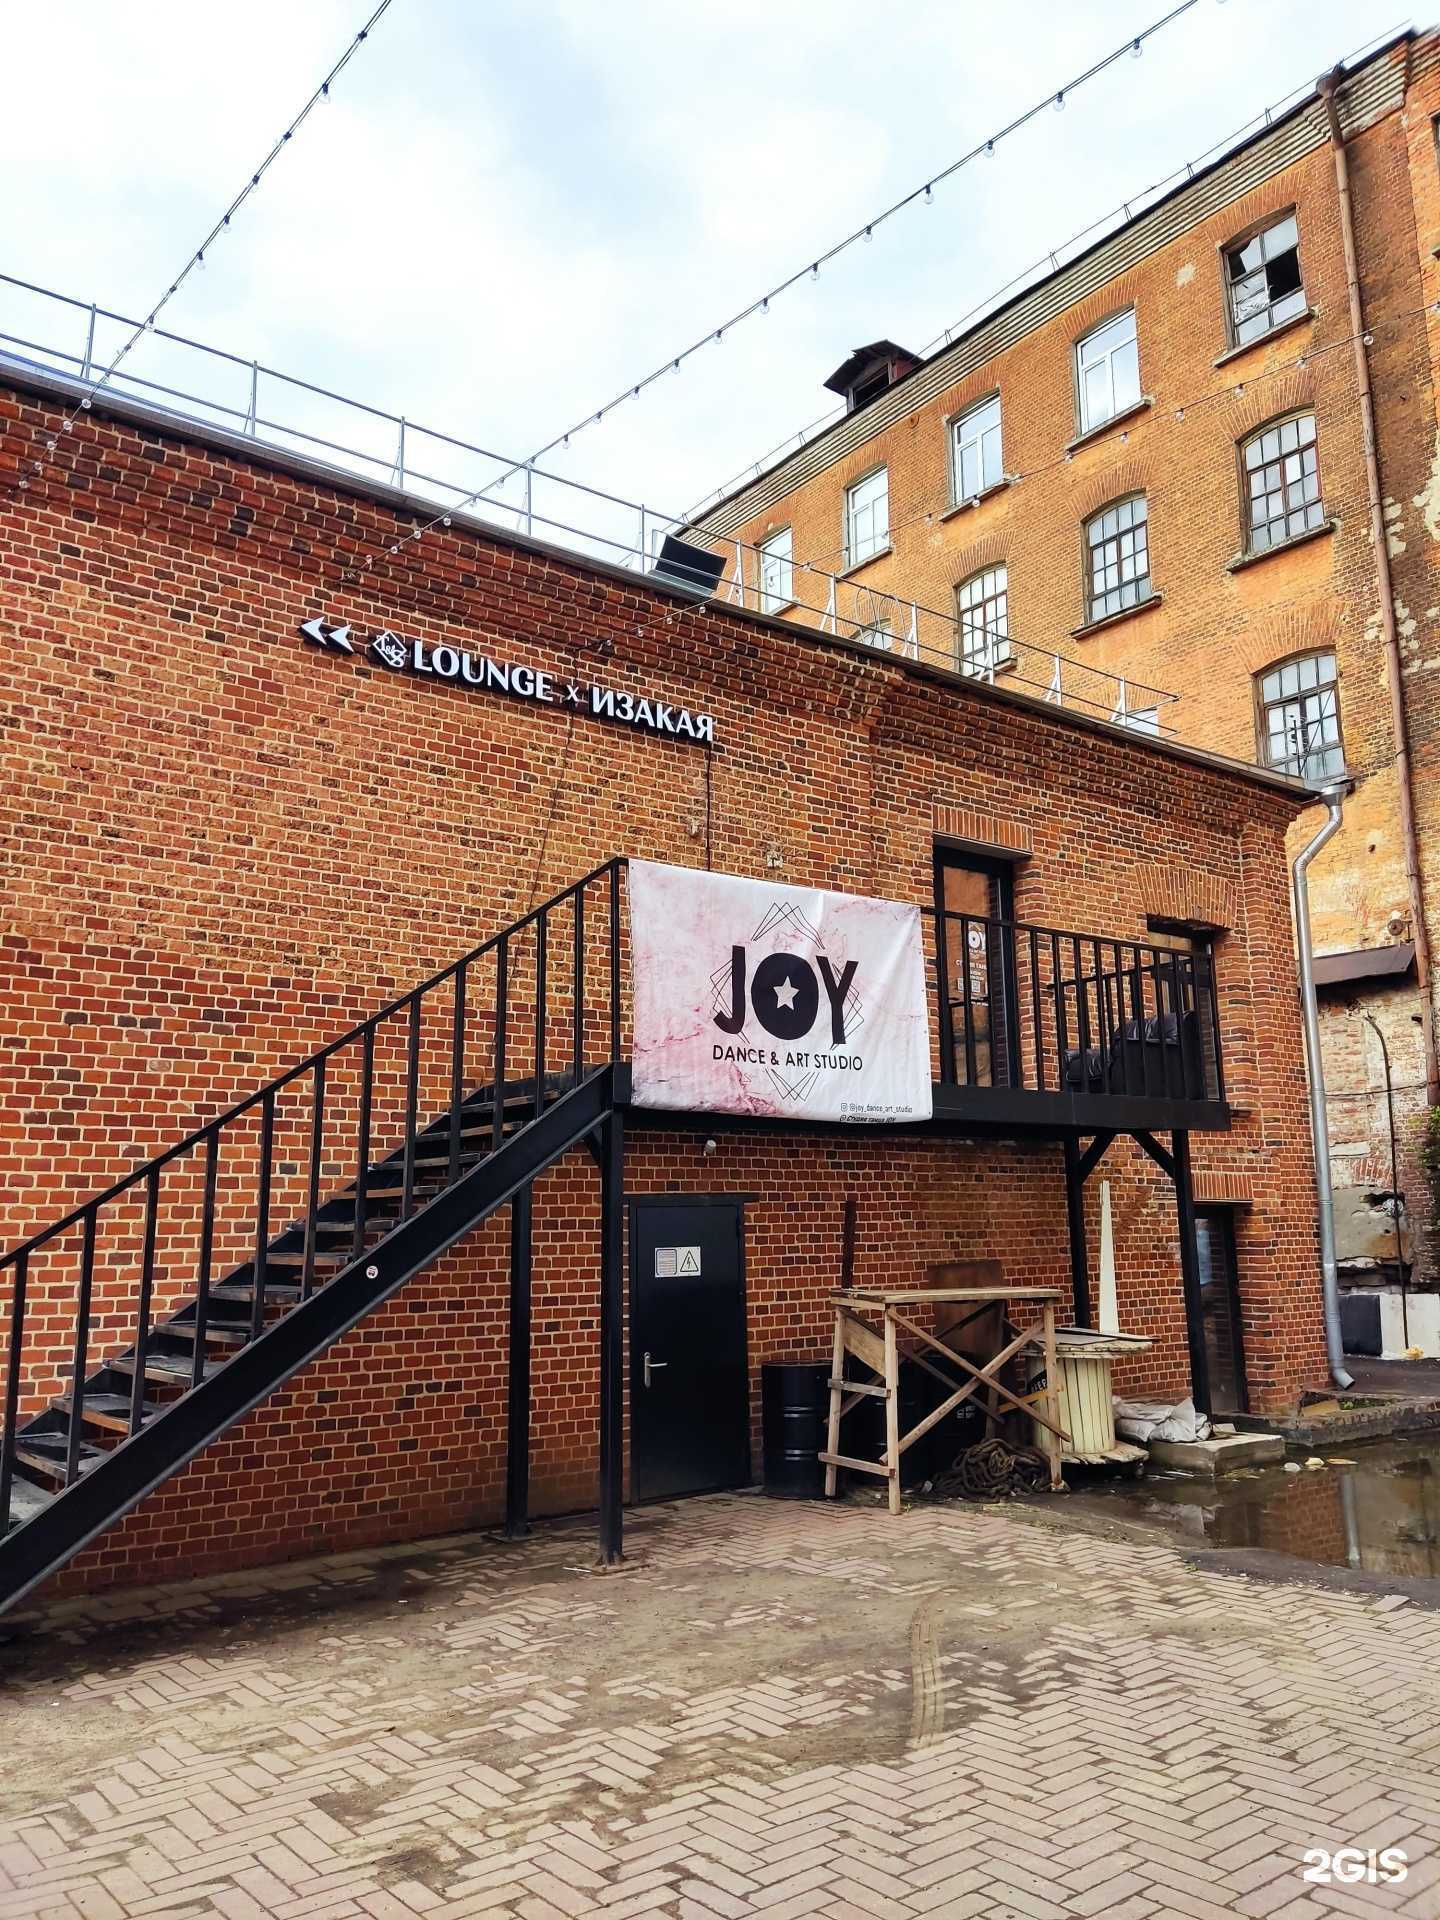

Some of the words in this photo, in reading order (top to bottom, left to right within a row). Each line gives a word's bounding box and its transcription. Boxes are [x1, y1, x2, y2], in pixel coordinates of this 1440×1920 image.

[414, 640, 554, 701] LOUNGE
[592, 686, 714, 742] ИЗАКАЯ
[712, 945, 859, 1045] JOY
[712, 1044, 766, 1065] DANCE
[770, 1051, 780, 1066] &
[785, 1052, 810, 1068] ART
[814, 1053, 863, 1071] STUDIO
